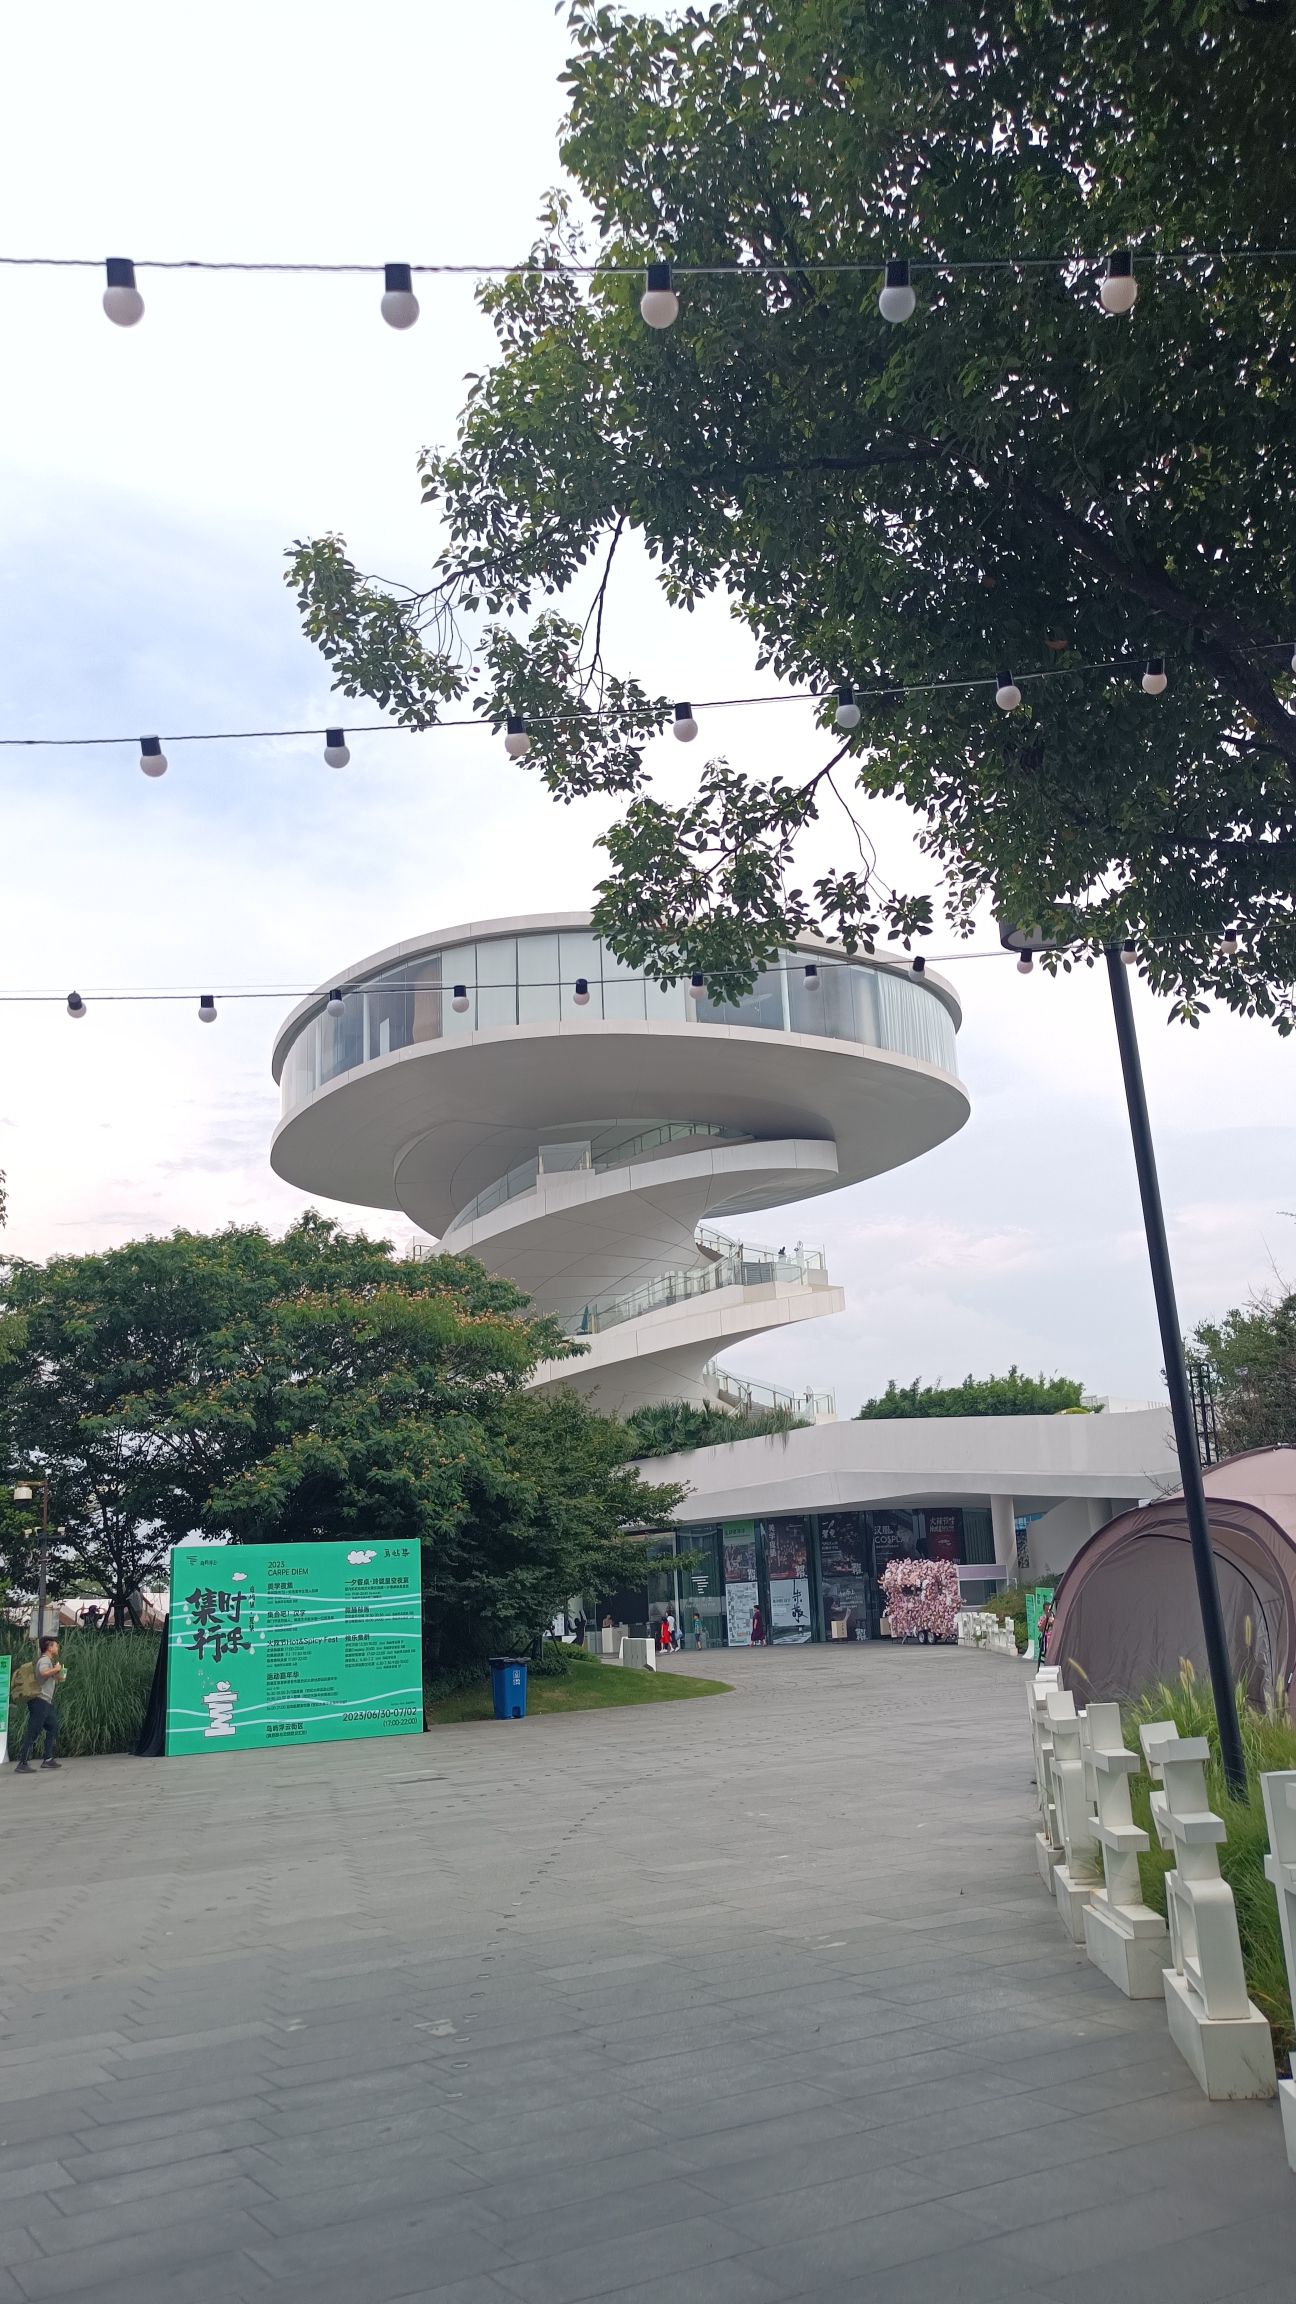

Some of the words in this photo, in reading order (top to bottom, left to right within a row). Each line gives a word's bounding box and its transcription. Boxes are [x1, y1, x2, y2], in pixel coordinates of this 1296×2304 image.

[268, 1561, 285, 1569] 2023
[268, 1569, 290, 1577] CARPE
[291, 1568, 309, 1576] DIEM
[342, 1707, 417, 1722] 2023/06/30-07/02
